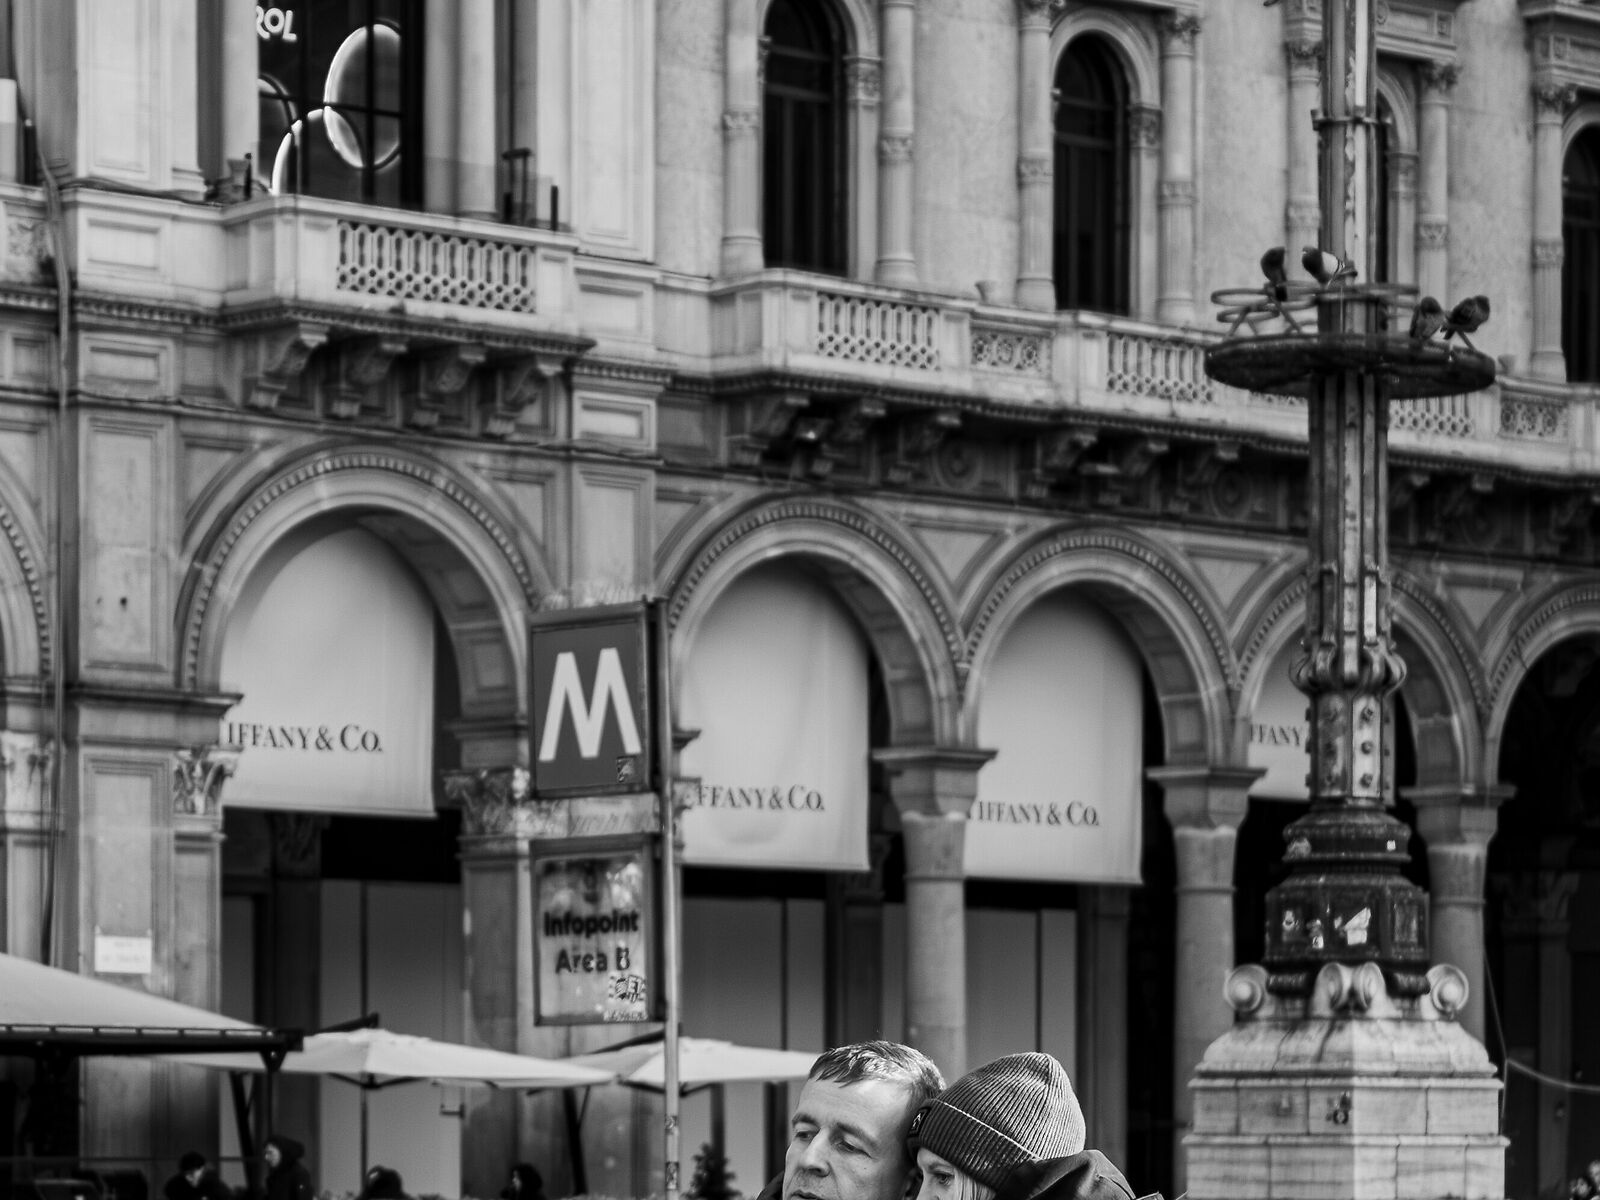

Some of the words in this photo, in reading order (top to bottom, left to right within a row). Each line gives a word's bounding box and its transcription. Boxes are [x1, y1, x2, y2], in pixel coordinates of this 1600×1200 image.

[538, 647, 642, 762] M
[543, 908, 639, 939] Infopoint
[555, 948, 608, 974] Area
